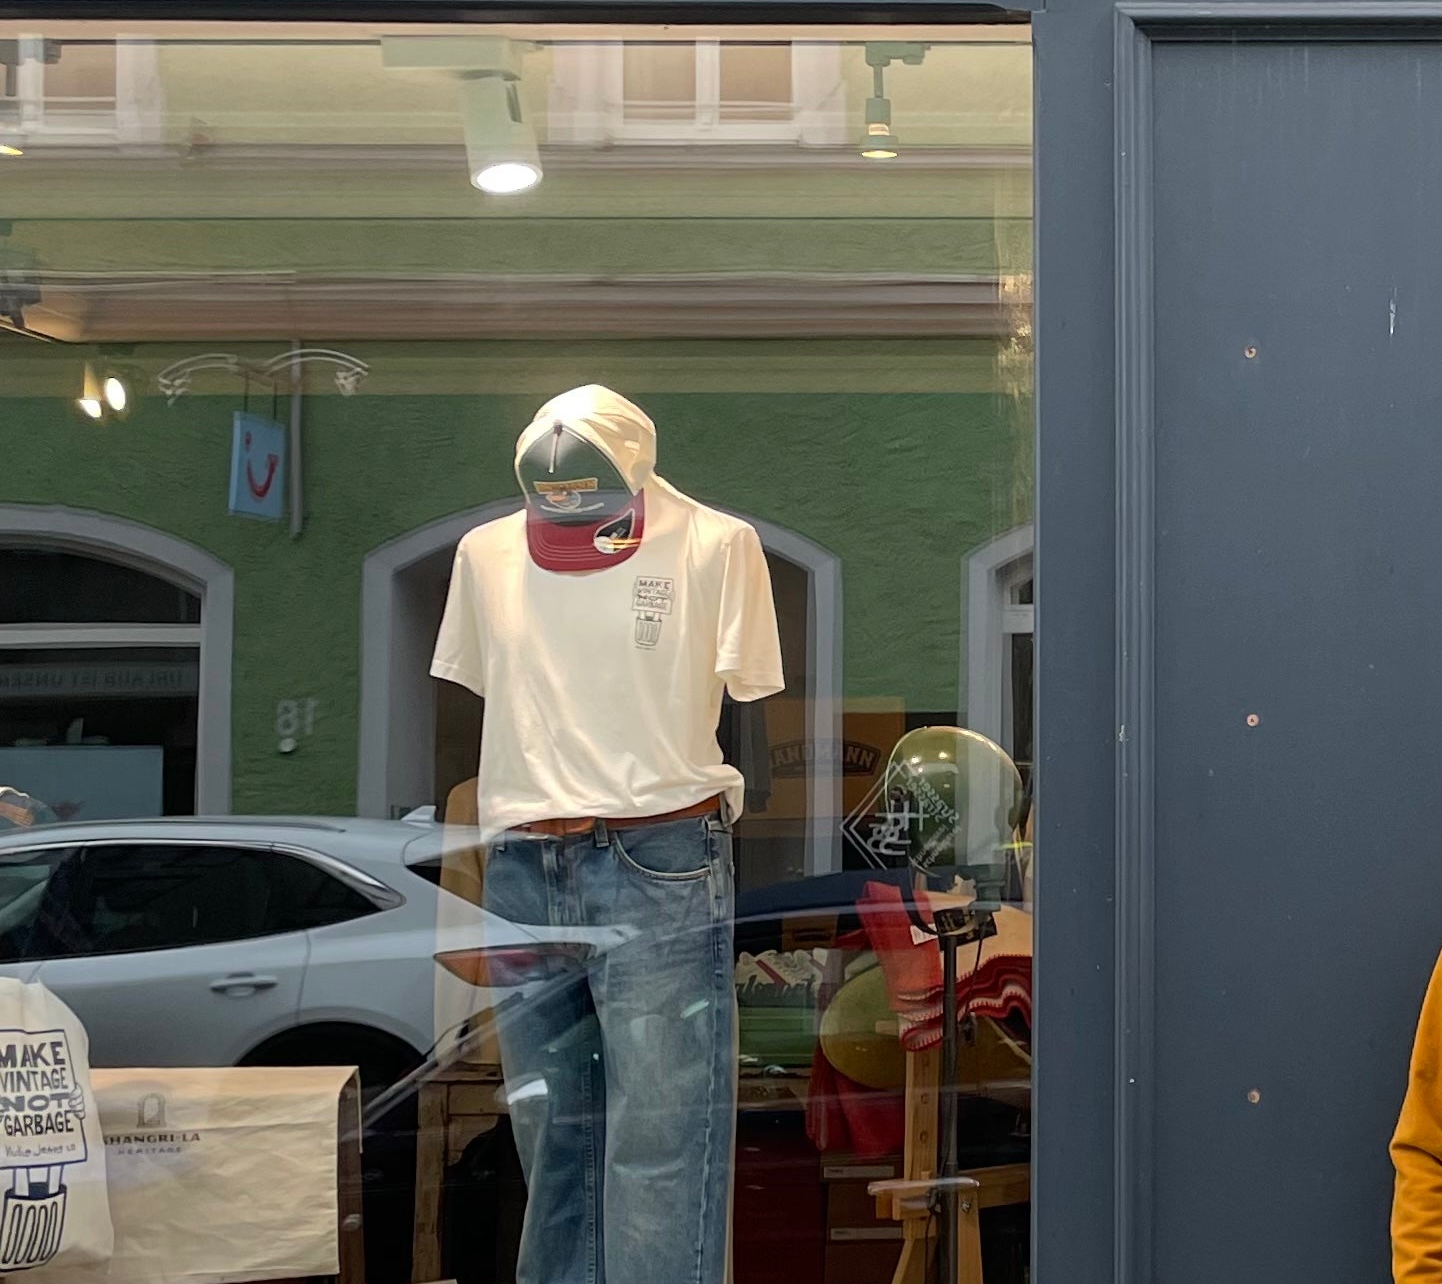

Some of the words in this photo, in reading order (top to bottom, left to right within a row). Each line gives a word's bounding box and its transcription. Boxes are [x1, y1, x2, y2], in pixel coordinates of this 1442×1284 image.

[639, 580, 671, 590] MAKE
[0, 1041, 66, 1069] MAKE
[0, 1067, 69, 1094] VINTAGE
[0, 1092, 72, 1113] NOT
[4, 1110, 75, 1137] GARBAGE
